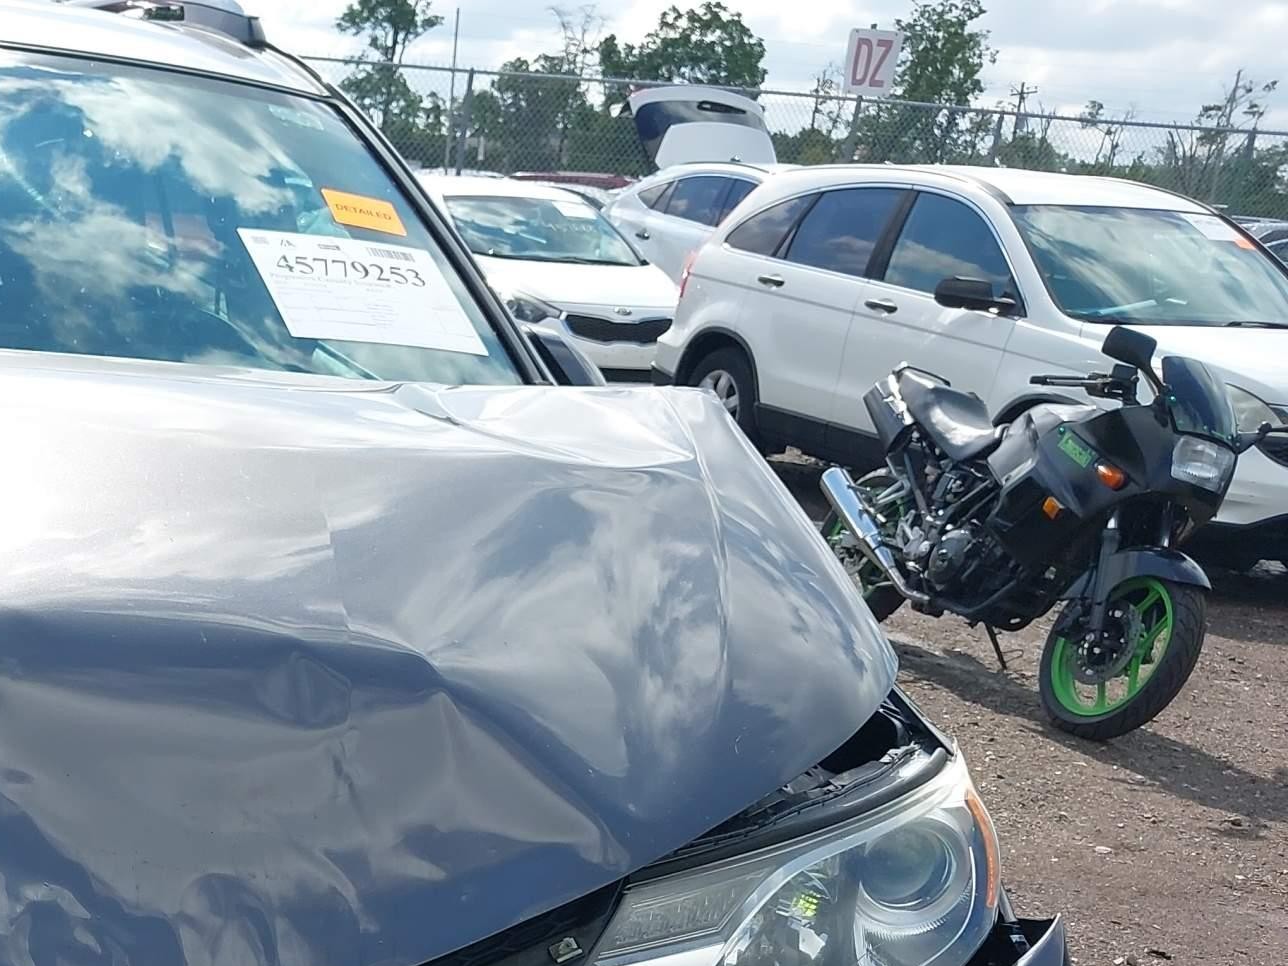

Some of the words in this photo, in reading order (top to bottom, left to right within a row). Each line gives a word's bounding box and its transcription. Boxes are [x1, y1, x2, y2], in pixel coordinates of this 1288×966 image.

[851, 37, 894, 88] DZ
[335, 203, 392, 221] DETAILED
[276, 254, 426, 288] 45779253
